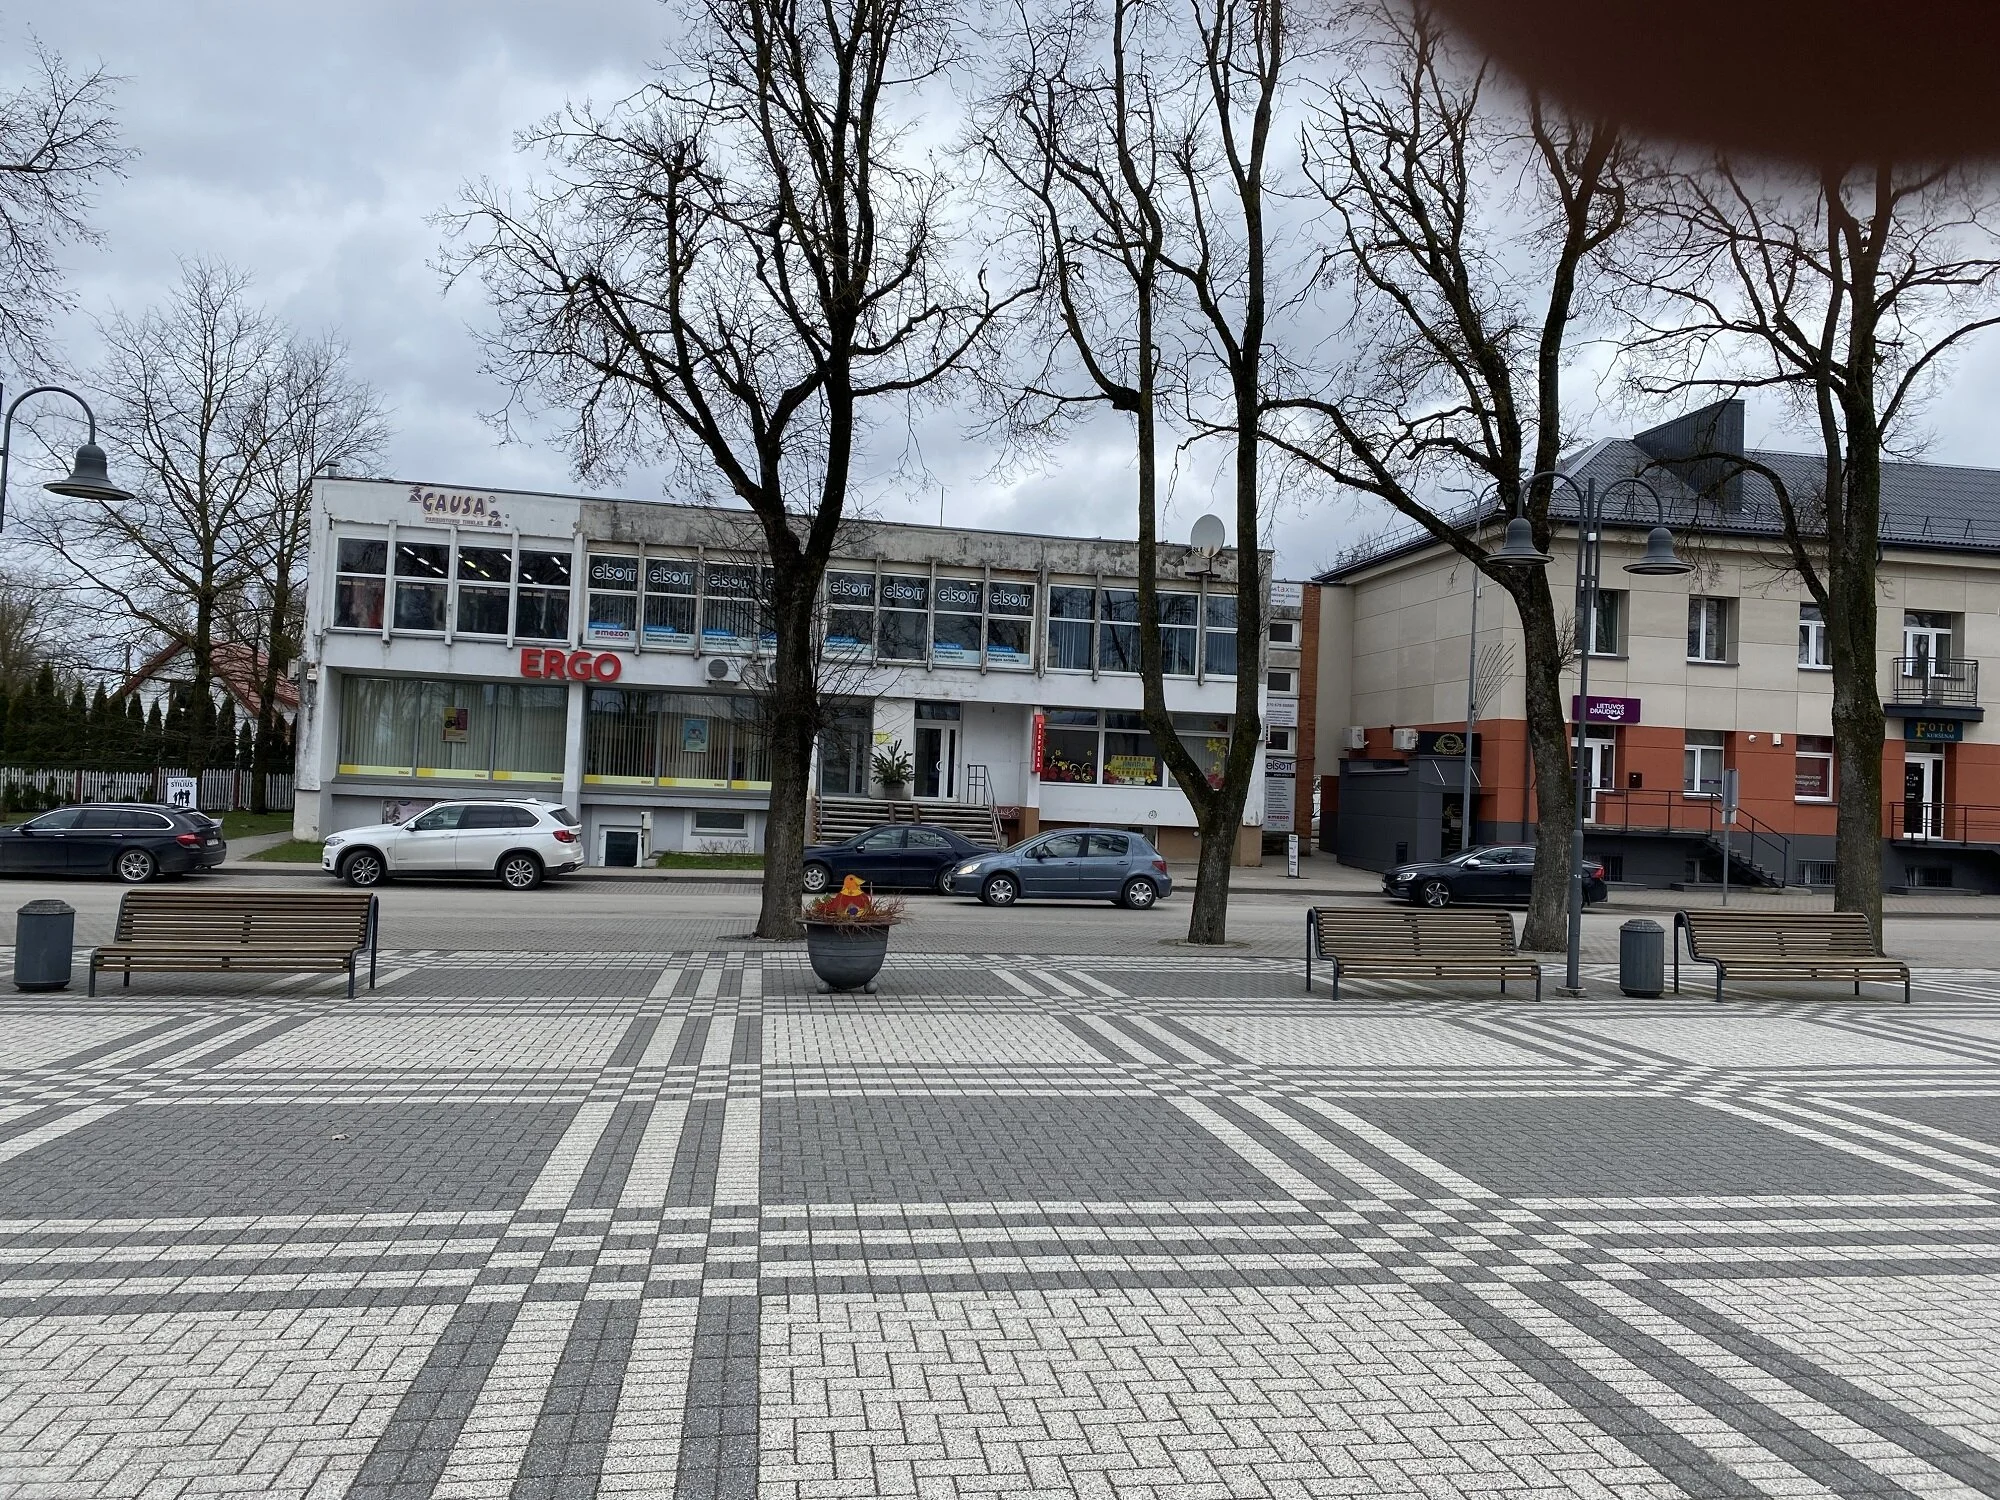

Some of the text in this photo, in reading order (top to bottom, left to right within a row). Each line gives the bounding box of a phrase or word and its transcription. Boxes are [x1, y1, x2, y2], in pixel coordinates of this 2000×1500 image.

[422, 492, 485, 515] GAUSA
[520, 648, 622, 682] ERGO
[1916, 722, 1954, 737] FOTO
